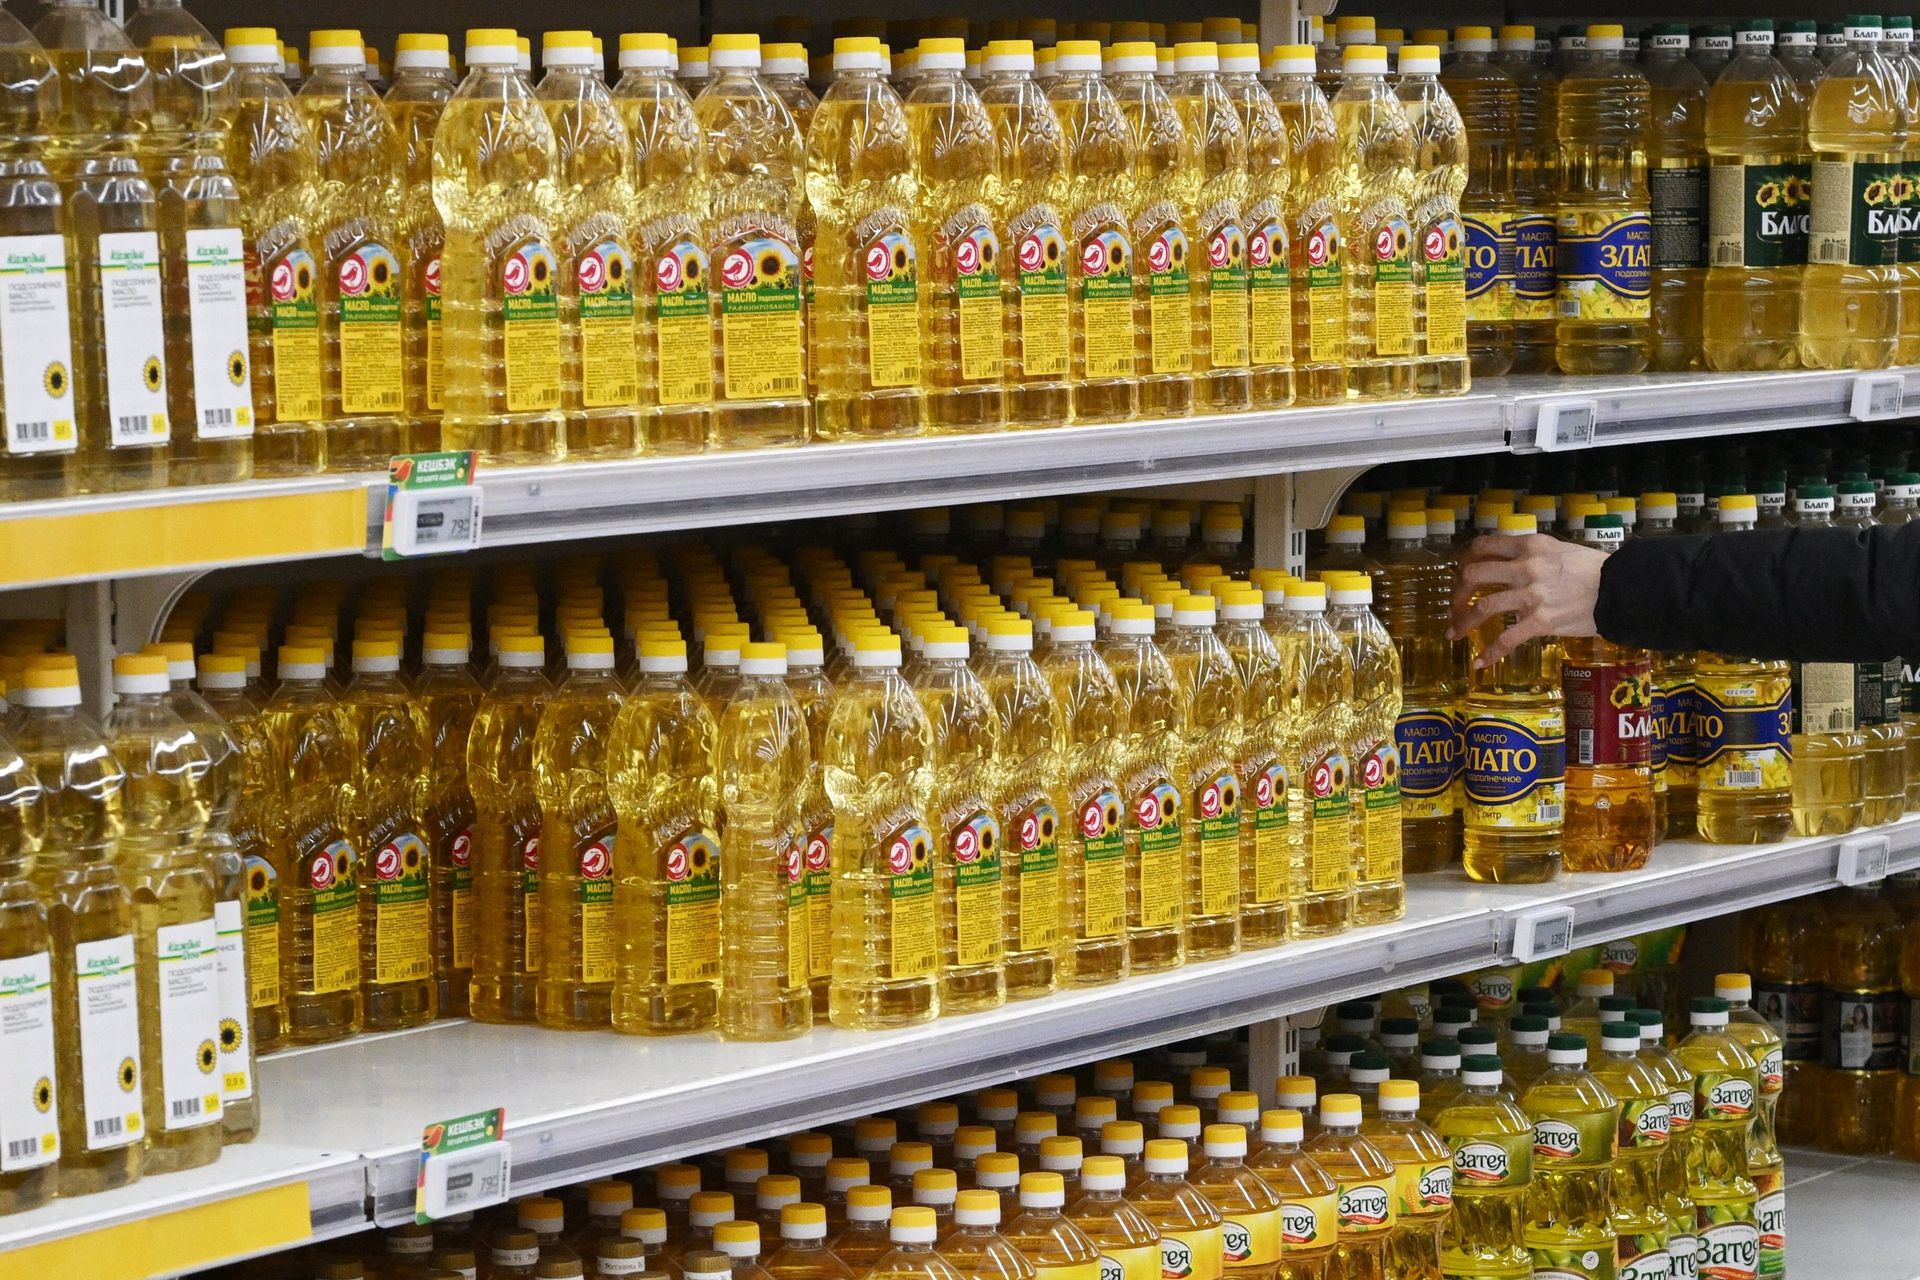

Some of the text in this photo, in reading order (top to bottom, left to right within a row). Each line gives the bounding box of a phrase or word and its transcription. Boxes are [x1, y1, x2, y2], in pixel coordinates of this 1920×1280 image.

[727, 292, 757, 303] МАСЛО
[1404, 727, 1440, 736] МАСЛО
[1398, 739, 1454, 764] ЛАТО
[1455, 1151, 1507, 1171] Затея
[1338, 1195, 1387, 1215] Затея
[1283, 1215, 1314, 1233] тея
